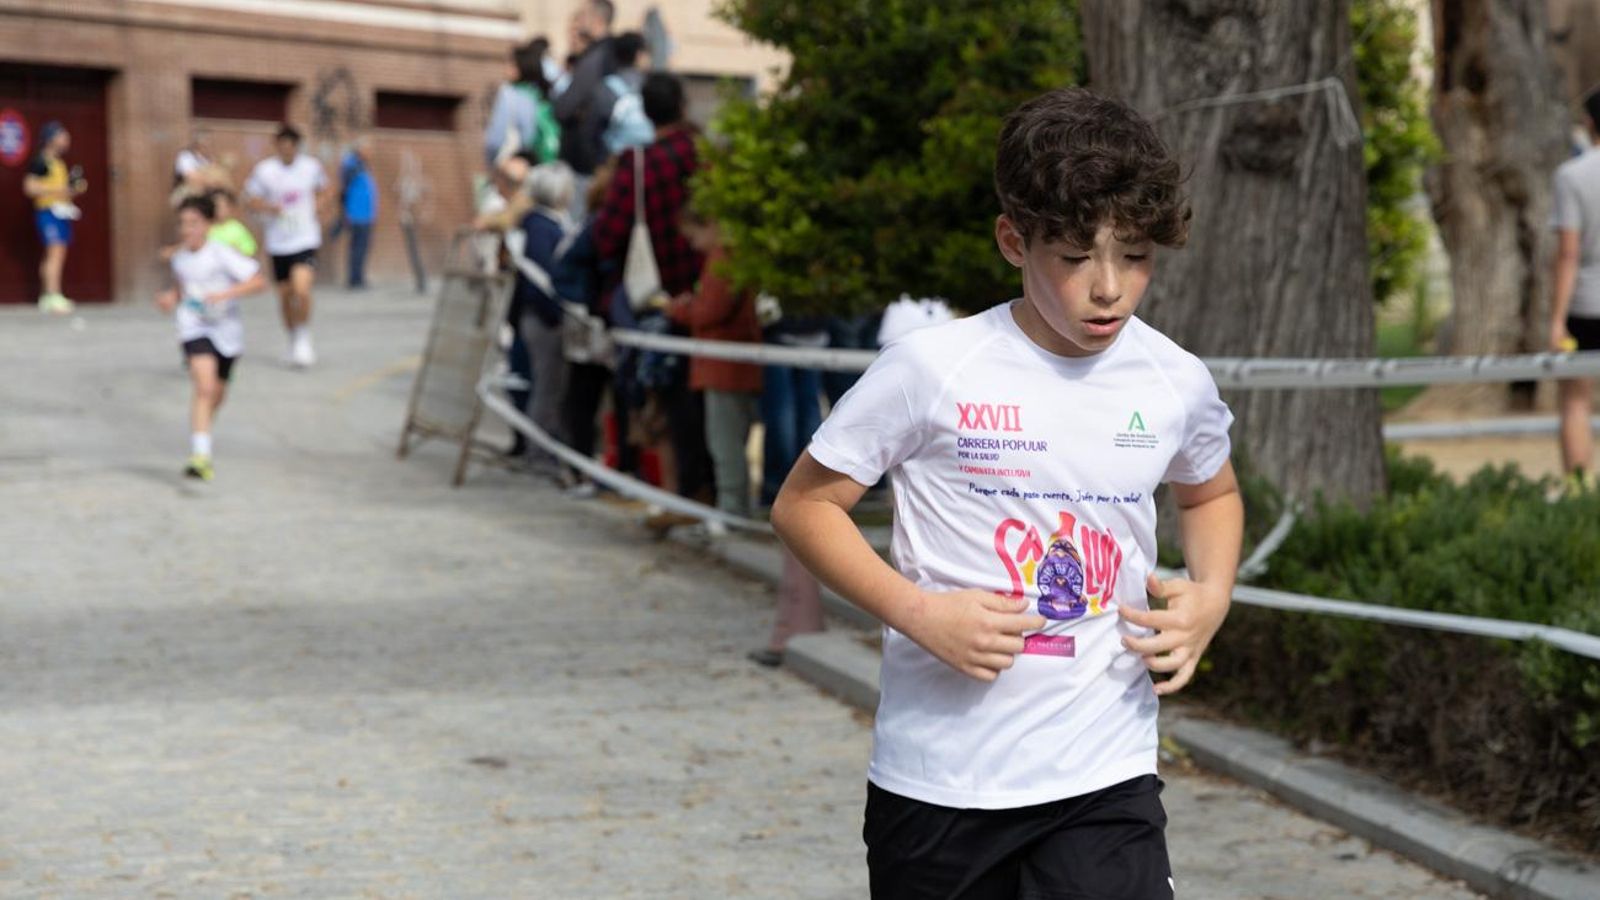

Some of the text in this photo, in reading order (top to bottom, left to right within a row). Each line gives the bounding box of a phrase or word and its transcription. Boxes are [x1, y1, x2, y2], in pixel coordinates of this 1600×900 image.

[957, 402, 1023, 431] XXVII
[957, 437, 1048, 452] CARRERA POPULAR
[958, 451, 1000, 461] POR LA SALUD
[964, 465, 996, 476] CAMINATA
[997, 468, 1031, 478] INCLUSIVA
[969, 482, 998, 496] Porque
[1000, 487, 1020, 497] cada
[1023, 492, 1040, 501] paso
